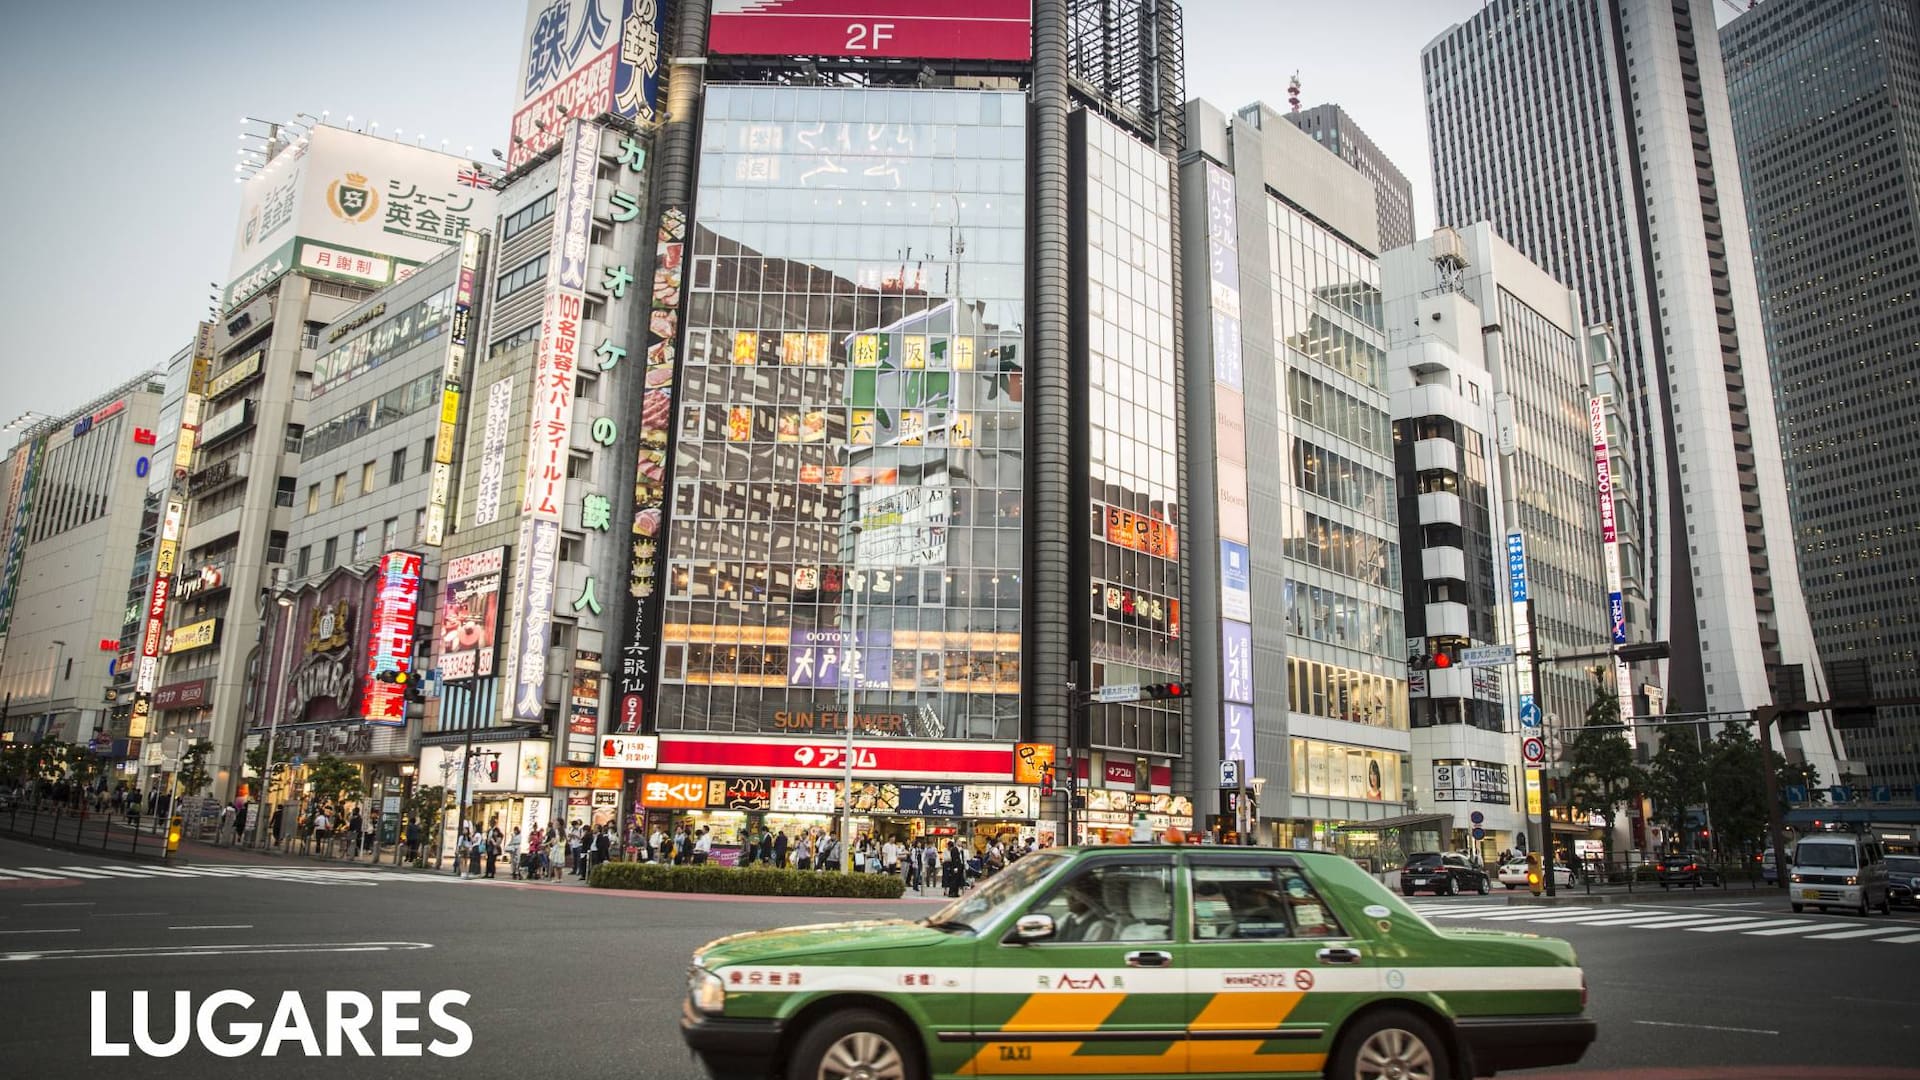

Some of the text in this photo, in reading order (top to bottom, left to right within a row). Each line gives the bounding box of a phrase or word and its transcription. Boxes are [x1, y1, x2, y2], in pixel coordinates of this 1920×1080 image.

[845, 24, 895, 50] 2F
[388, 179, 474, 213] シェーン
[561, 123, 599, 288] カラオケの鉄人
[384, 200, 471, 239] 英会話
[316, 252, 373, 275] 月謝制
[854, 341, 974, 363] 松阪牛
[573, 137, 647, 616] カラオケの鉄人
[538, 294, 580, 515] 100名収容大パーティールーム
[1110, 508, 1133, 530] 5F
[517, 521, 558, 718] カラオケの鉄人
[791, 647, 865, 685] 大戸屋
[288, 660, 354, 719] JUMBO
[775, 711, 814, 729] SUN
[815, 703, 860, 712] SHINJUU
[819, 747, 877, 768] アコム
[646, 781, 704, 802] 宝くじ
[918, 785, 955, 810] 大戸屋
[997, 1046, 1032, 1061] TAXI
